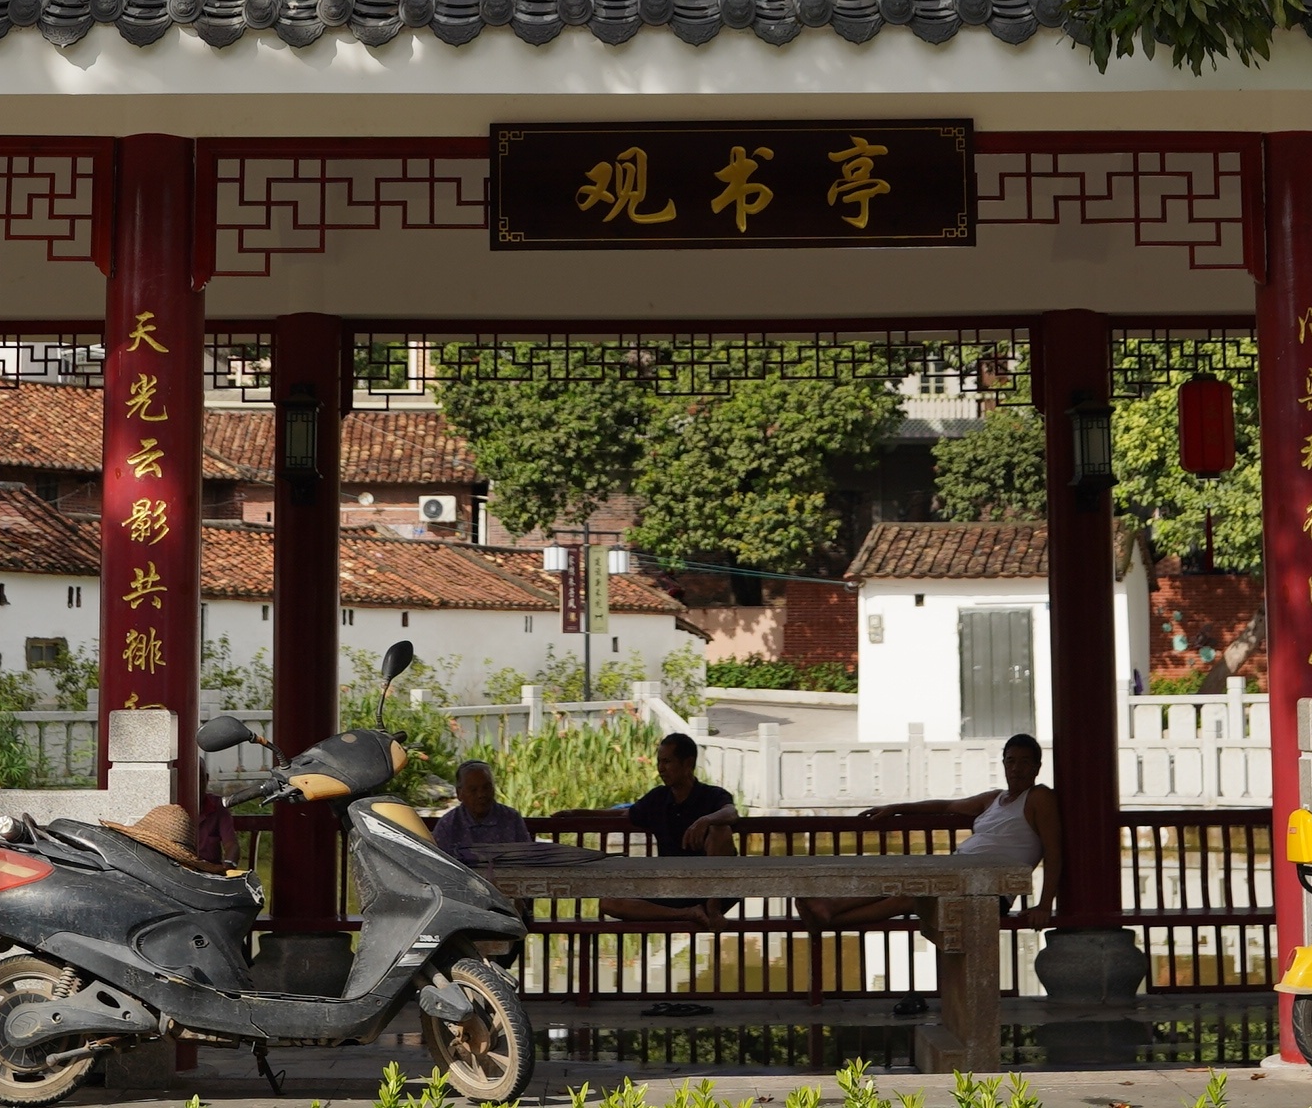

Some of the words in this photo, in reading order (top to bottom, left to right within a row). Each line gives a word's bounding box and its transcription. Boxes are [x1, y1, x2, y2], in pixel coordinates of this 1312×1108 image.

[576, 135, 891, 233] 观书亭
[122, 311, 169, 709] 天光云影共徘
